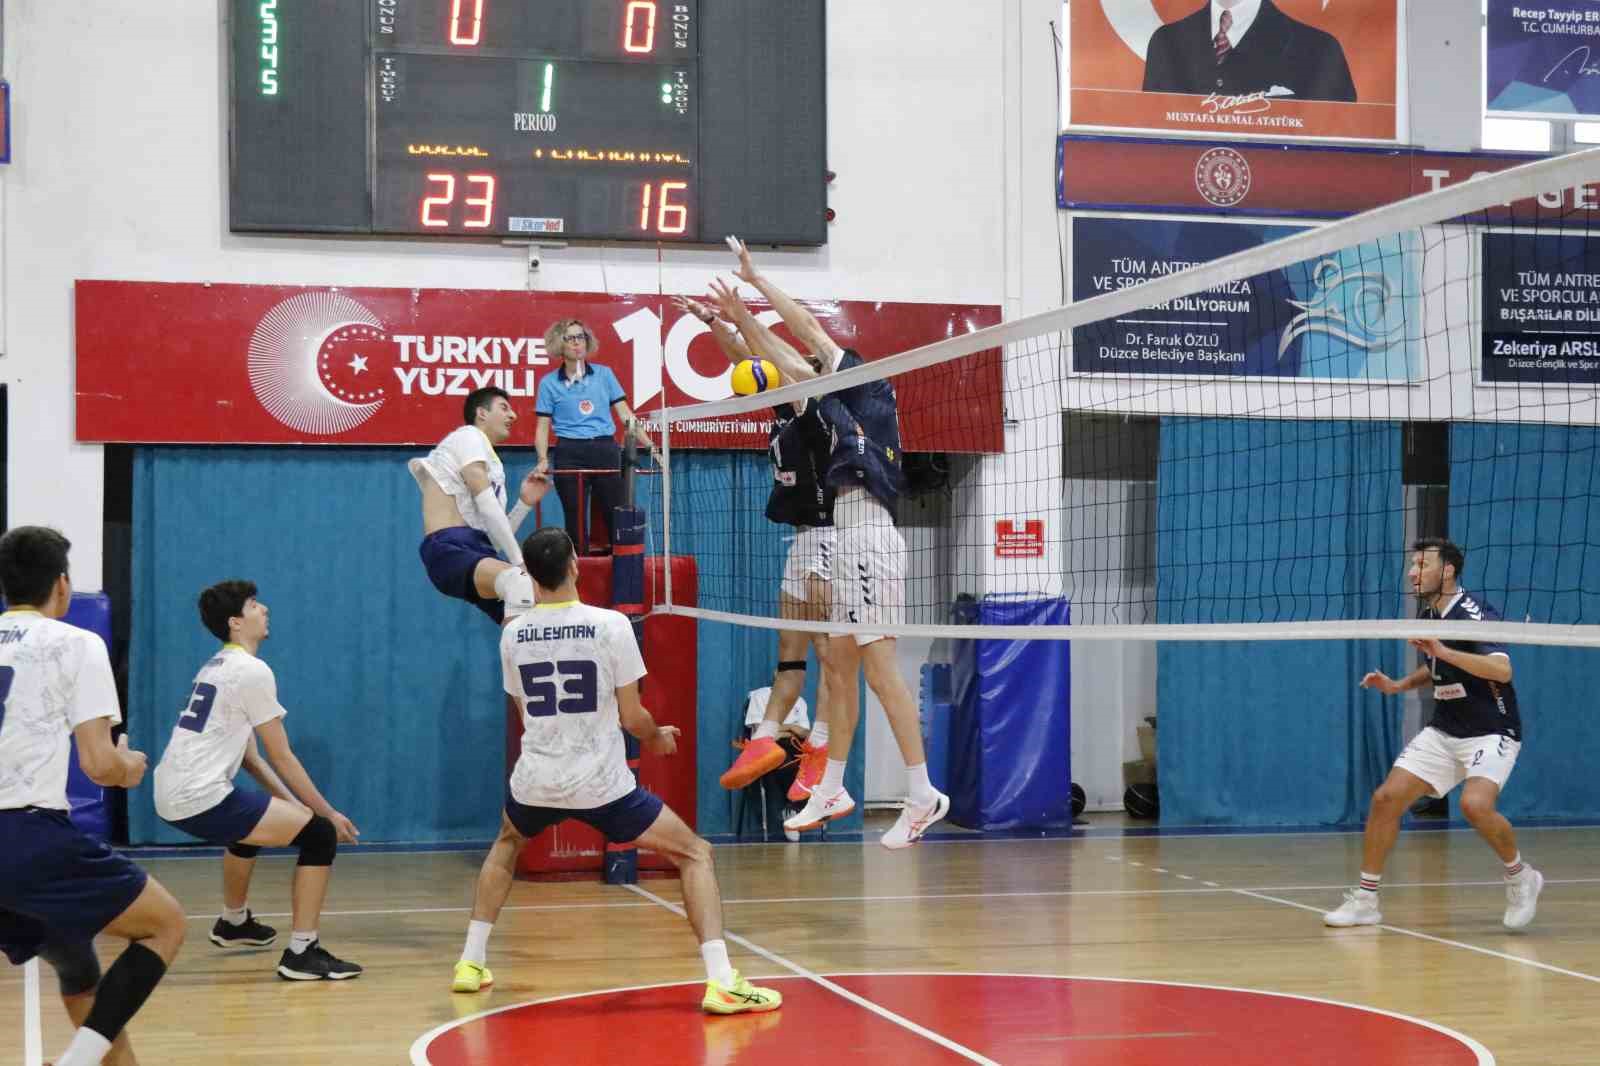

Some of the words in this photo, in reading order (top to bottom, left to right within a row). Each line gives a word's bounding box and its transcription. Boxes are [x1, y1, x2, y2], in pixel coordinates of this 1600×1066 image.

[450, 0, 483, 45] 0
[1513, 7, 1546, 20] Recep
[1548, 9, 1582, 22] Tayyip
[624, 1, 657, 52] 0
[1522, 22, 1539, 33] T.C.
[541, 63, 553, 112] 1
[514, 112, 557, 131] PERIOD
[1166, 111, 1215, 123] MUSTAFA
[1216, 113, 1256, 125] KEMAL
[1254, 115, 1303, 127] ATATÜRK
[422, 174, 495, 227] 23
[640, 182, 687, 233] 16
[1112, 257, 1146, 273] TÜM
[1093, 276, 1112, 290] VE
[1517, 270, 1550, 287] TÜM
[1500, 288, 1519, 302] VE
[1174, 297, 1250, 312] DİLİYORUM
[1126, 333, 1144, 345] Dr.
[1147, 334, 1181, 346] Faruk
[1185, 333, 1219, 347] ÖZLÜ
[393, 335, 549, 365] TÜRKİYE
[1099, 347, 1138, 359] Düzce
[1142, 348, 1194, 363] Belediye
[1198, 349, 1245, 364] Başkanı
[1493, 340, 1557, 358] Zekeriya
[1508, 358, 1535, 369] Düzce
[1536, 359, 1566, 371] Gençlik
[1568, 361, 1579, 369] ve
[517, 623, 596, 643] SÜLEYMAN
[518, 660, 597, 717] 53
